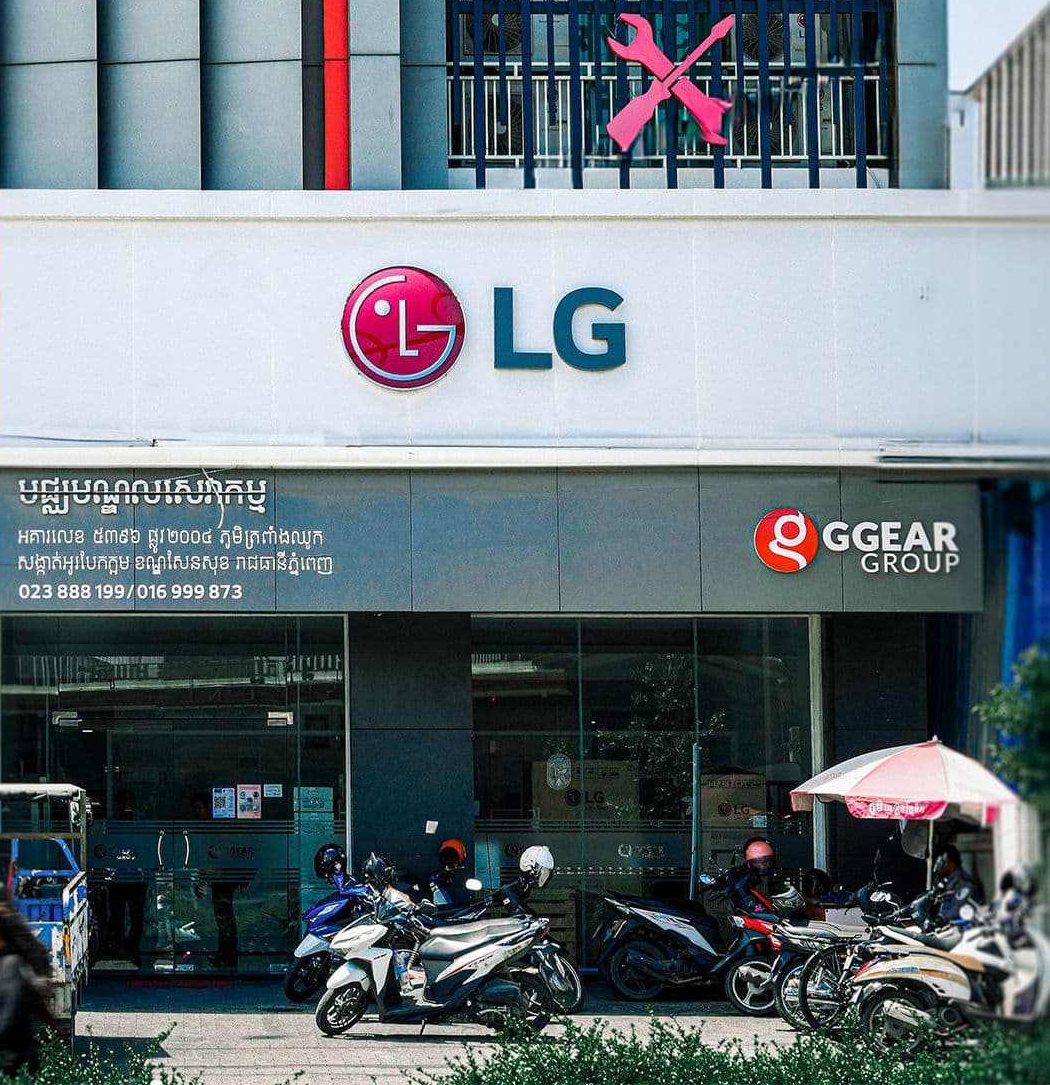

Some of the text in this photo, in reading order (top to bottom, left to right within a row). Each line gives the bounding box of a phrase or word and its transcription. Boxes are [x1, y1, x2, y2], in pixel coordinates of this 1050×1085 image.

[493, 286, 627, 371] LG
[822, 521, 959, 552] GGEAR
[861, 553, 960, 573] GROUP
[18, 584, 53, 599] 023
[57, 584, 92, 599] 888
[171, 584, 205, 599] 999
[208, 584, 243, 599] 873
[585, 791, 604, 804] LG
[733, 804, 751, 815] LG
